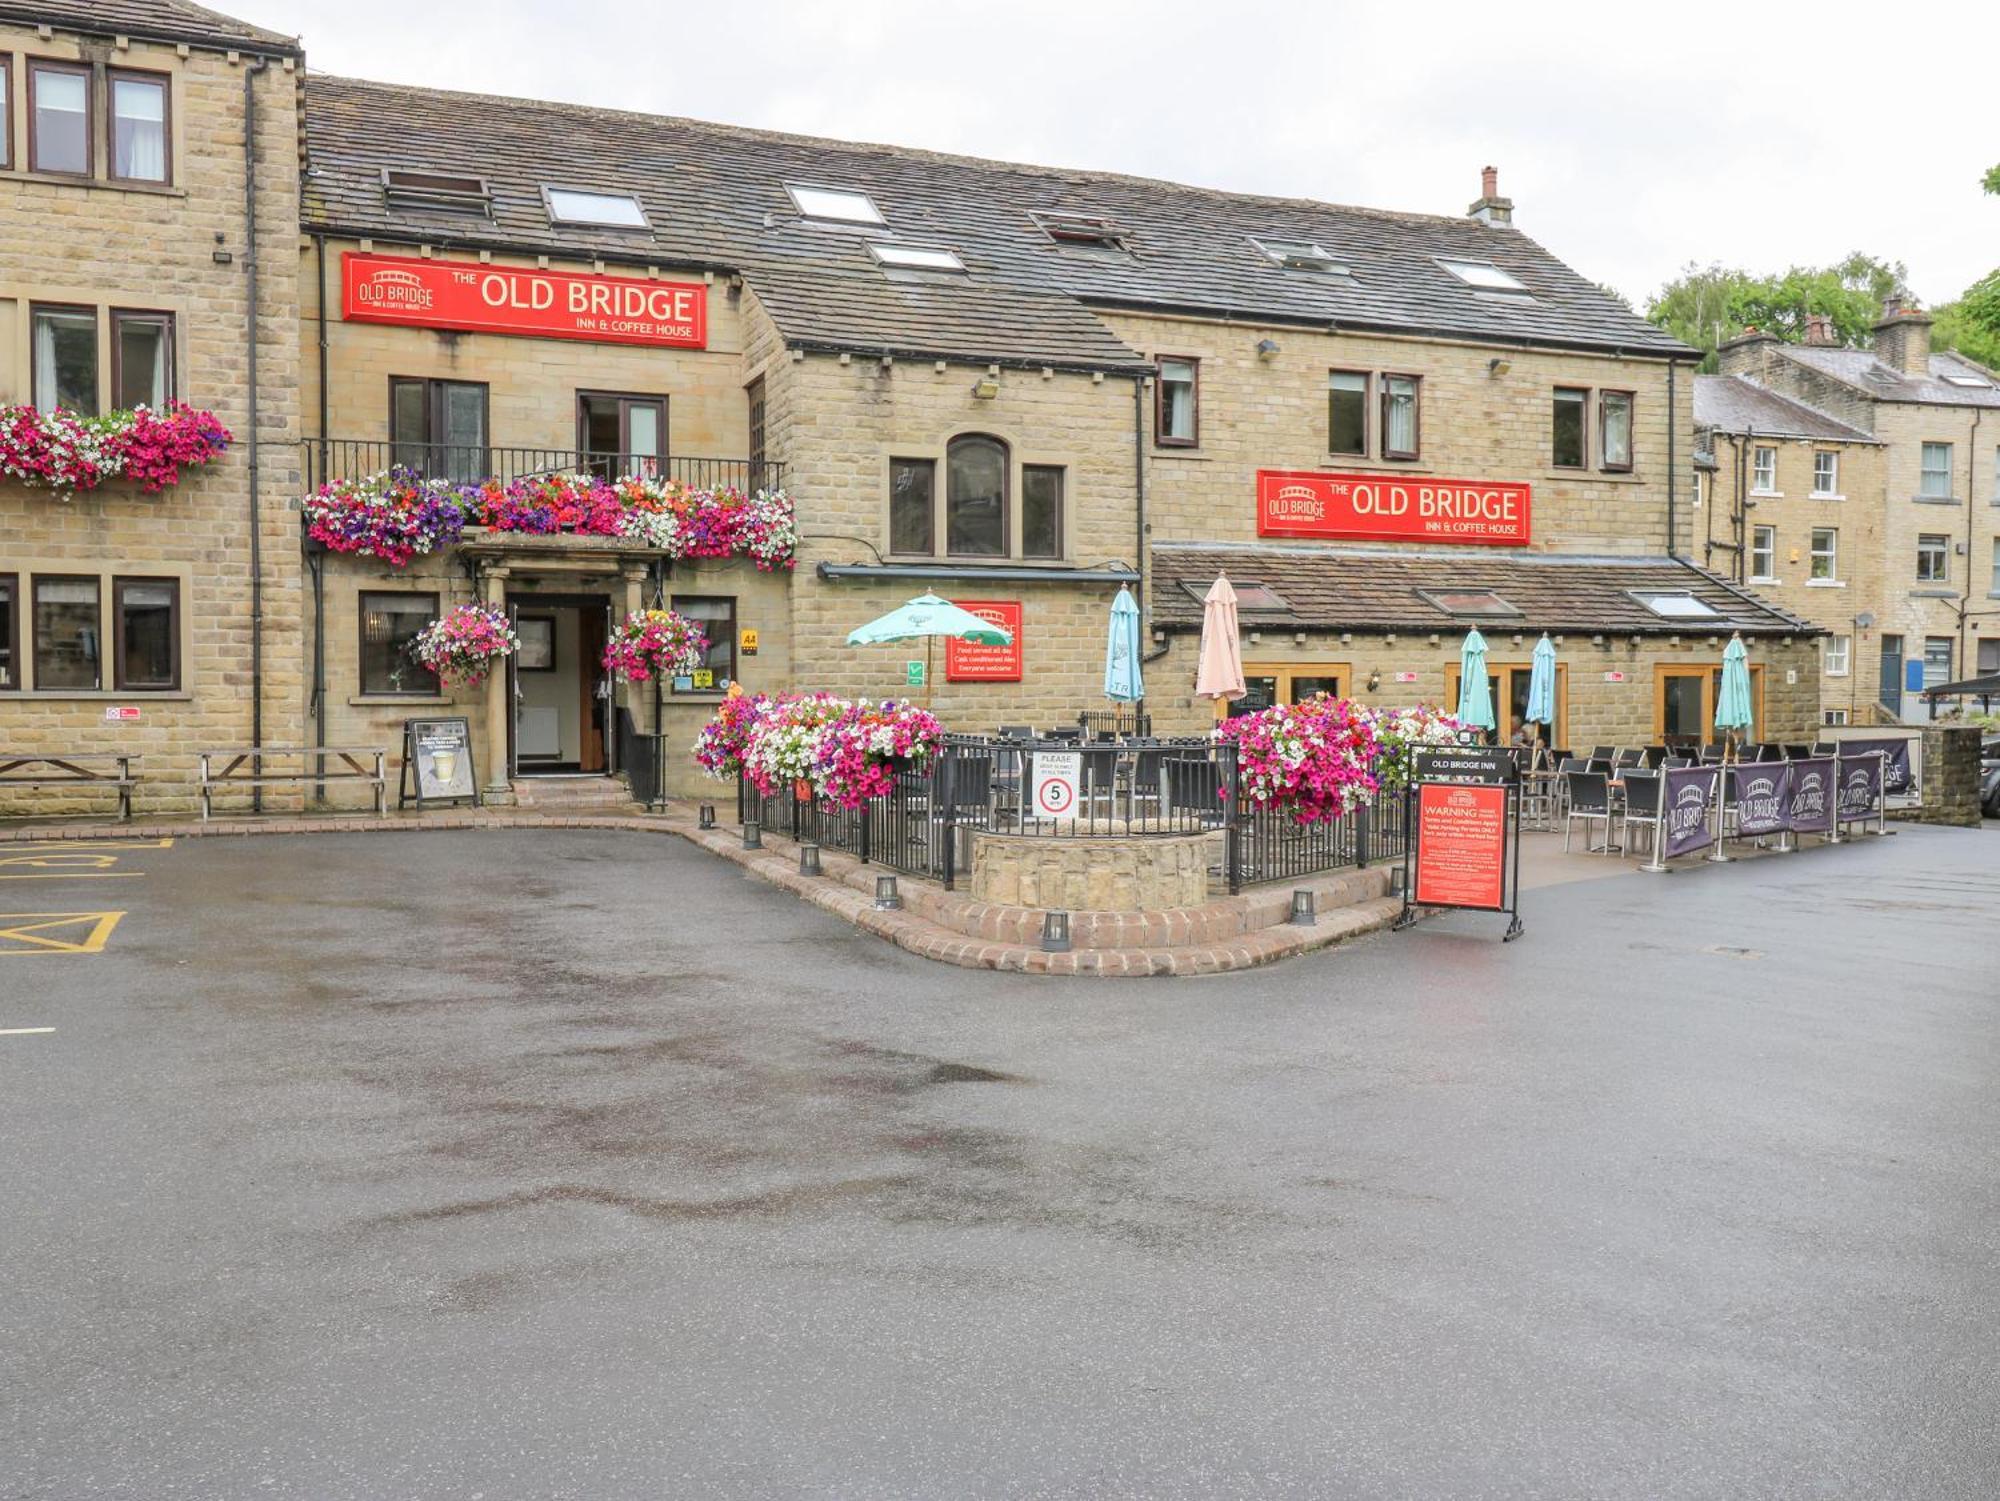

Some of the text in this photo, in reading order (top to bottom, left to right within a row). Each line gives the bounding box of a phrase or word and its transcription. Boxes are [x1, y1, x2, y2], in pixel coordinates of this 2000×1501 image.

[452, 272, 476, 286] THE
[359, 283, 434, 307] OLD BRIDGE
[481, 274, 693, 322] OLD BRIDGE
[576, 317, 693, 337] INN & COFFEE HOUSE
[1330, 484, 1349, 496] THE
[1269, 499, 1326, 518] OLD BRIDGE
[1352, 484, 1518, 520] OLD BRIDGE
[1425, 521, 1518, 534] INN & COFFEE HOUSE
[743, 634, 756, 645] AA
[1041, 755, 1072, 763] PLEASE
[1432, 760, 1496, 770] OLD BRIDGE INN
[1051, 785, 1060, 800] 5
[1424, 806, 1477, 818] WARNING
[1753, 797, 1781, 820] BRIDGE
